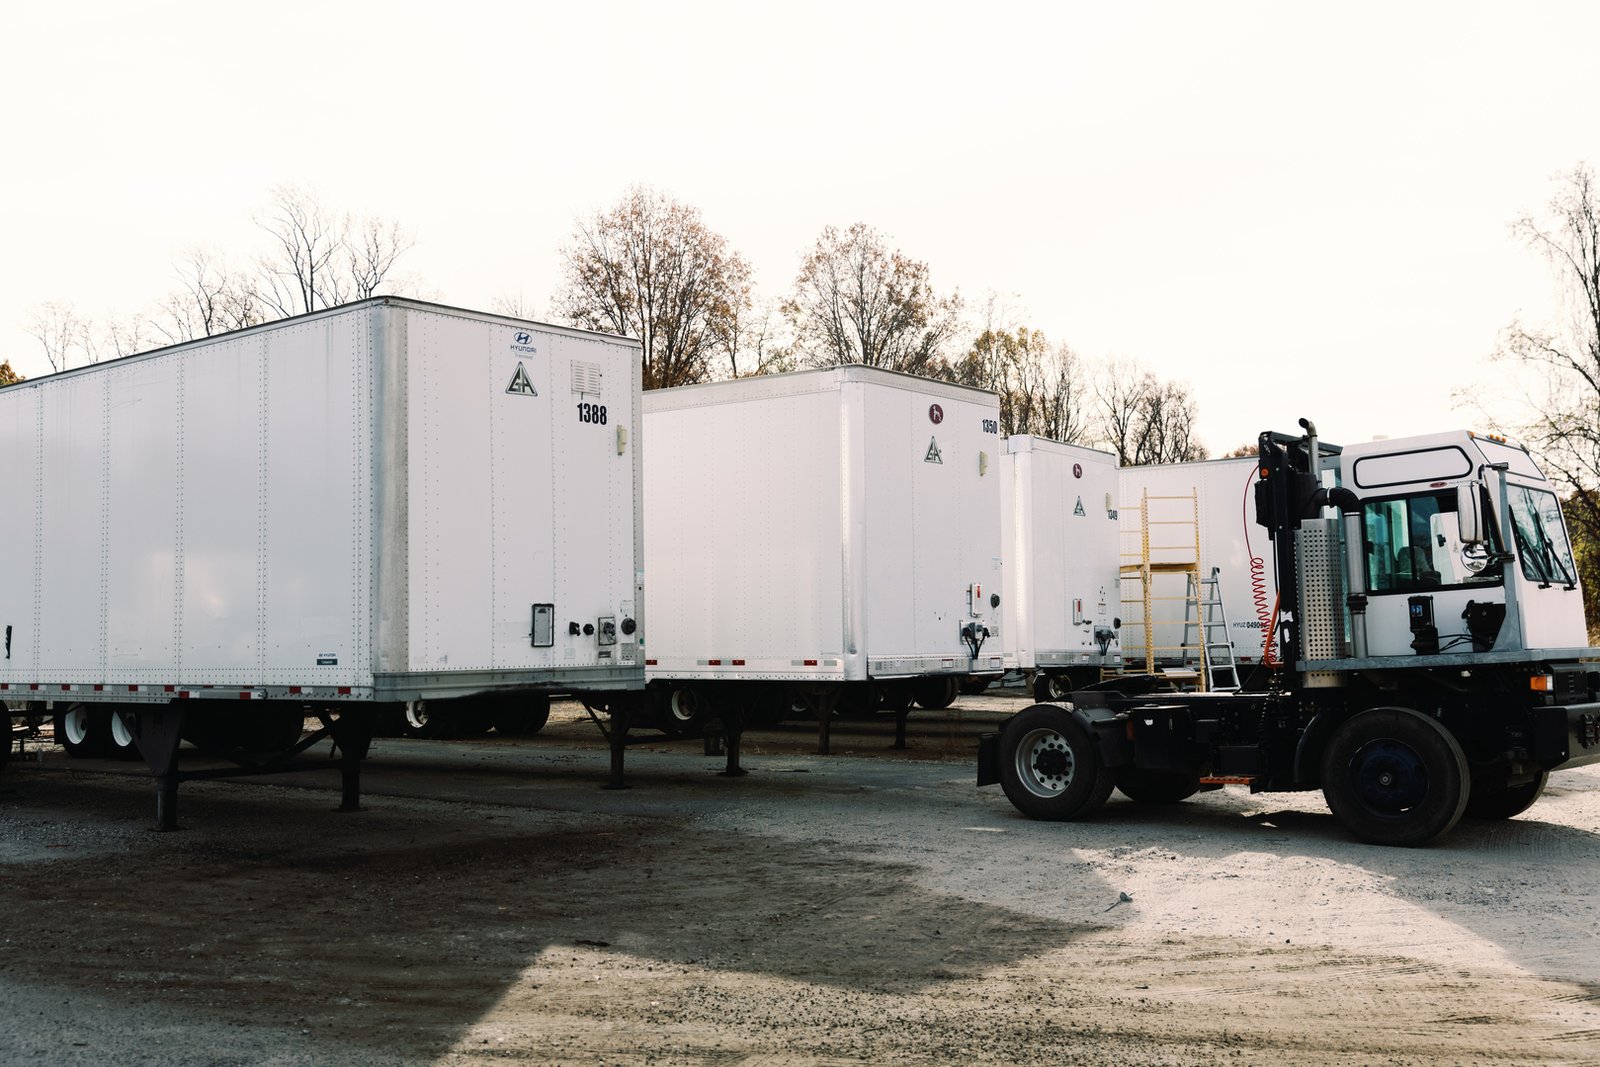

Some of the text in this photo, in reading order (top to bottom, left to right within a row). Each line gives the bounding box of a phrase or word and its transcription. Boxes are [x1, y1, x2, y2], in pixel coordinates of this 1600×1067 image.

[577, 403, 607, 425] 1388
[982, 419, 998, 434] 1350
[1107, 509, 1118, 520] 1349
